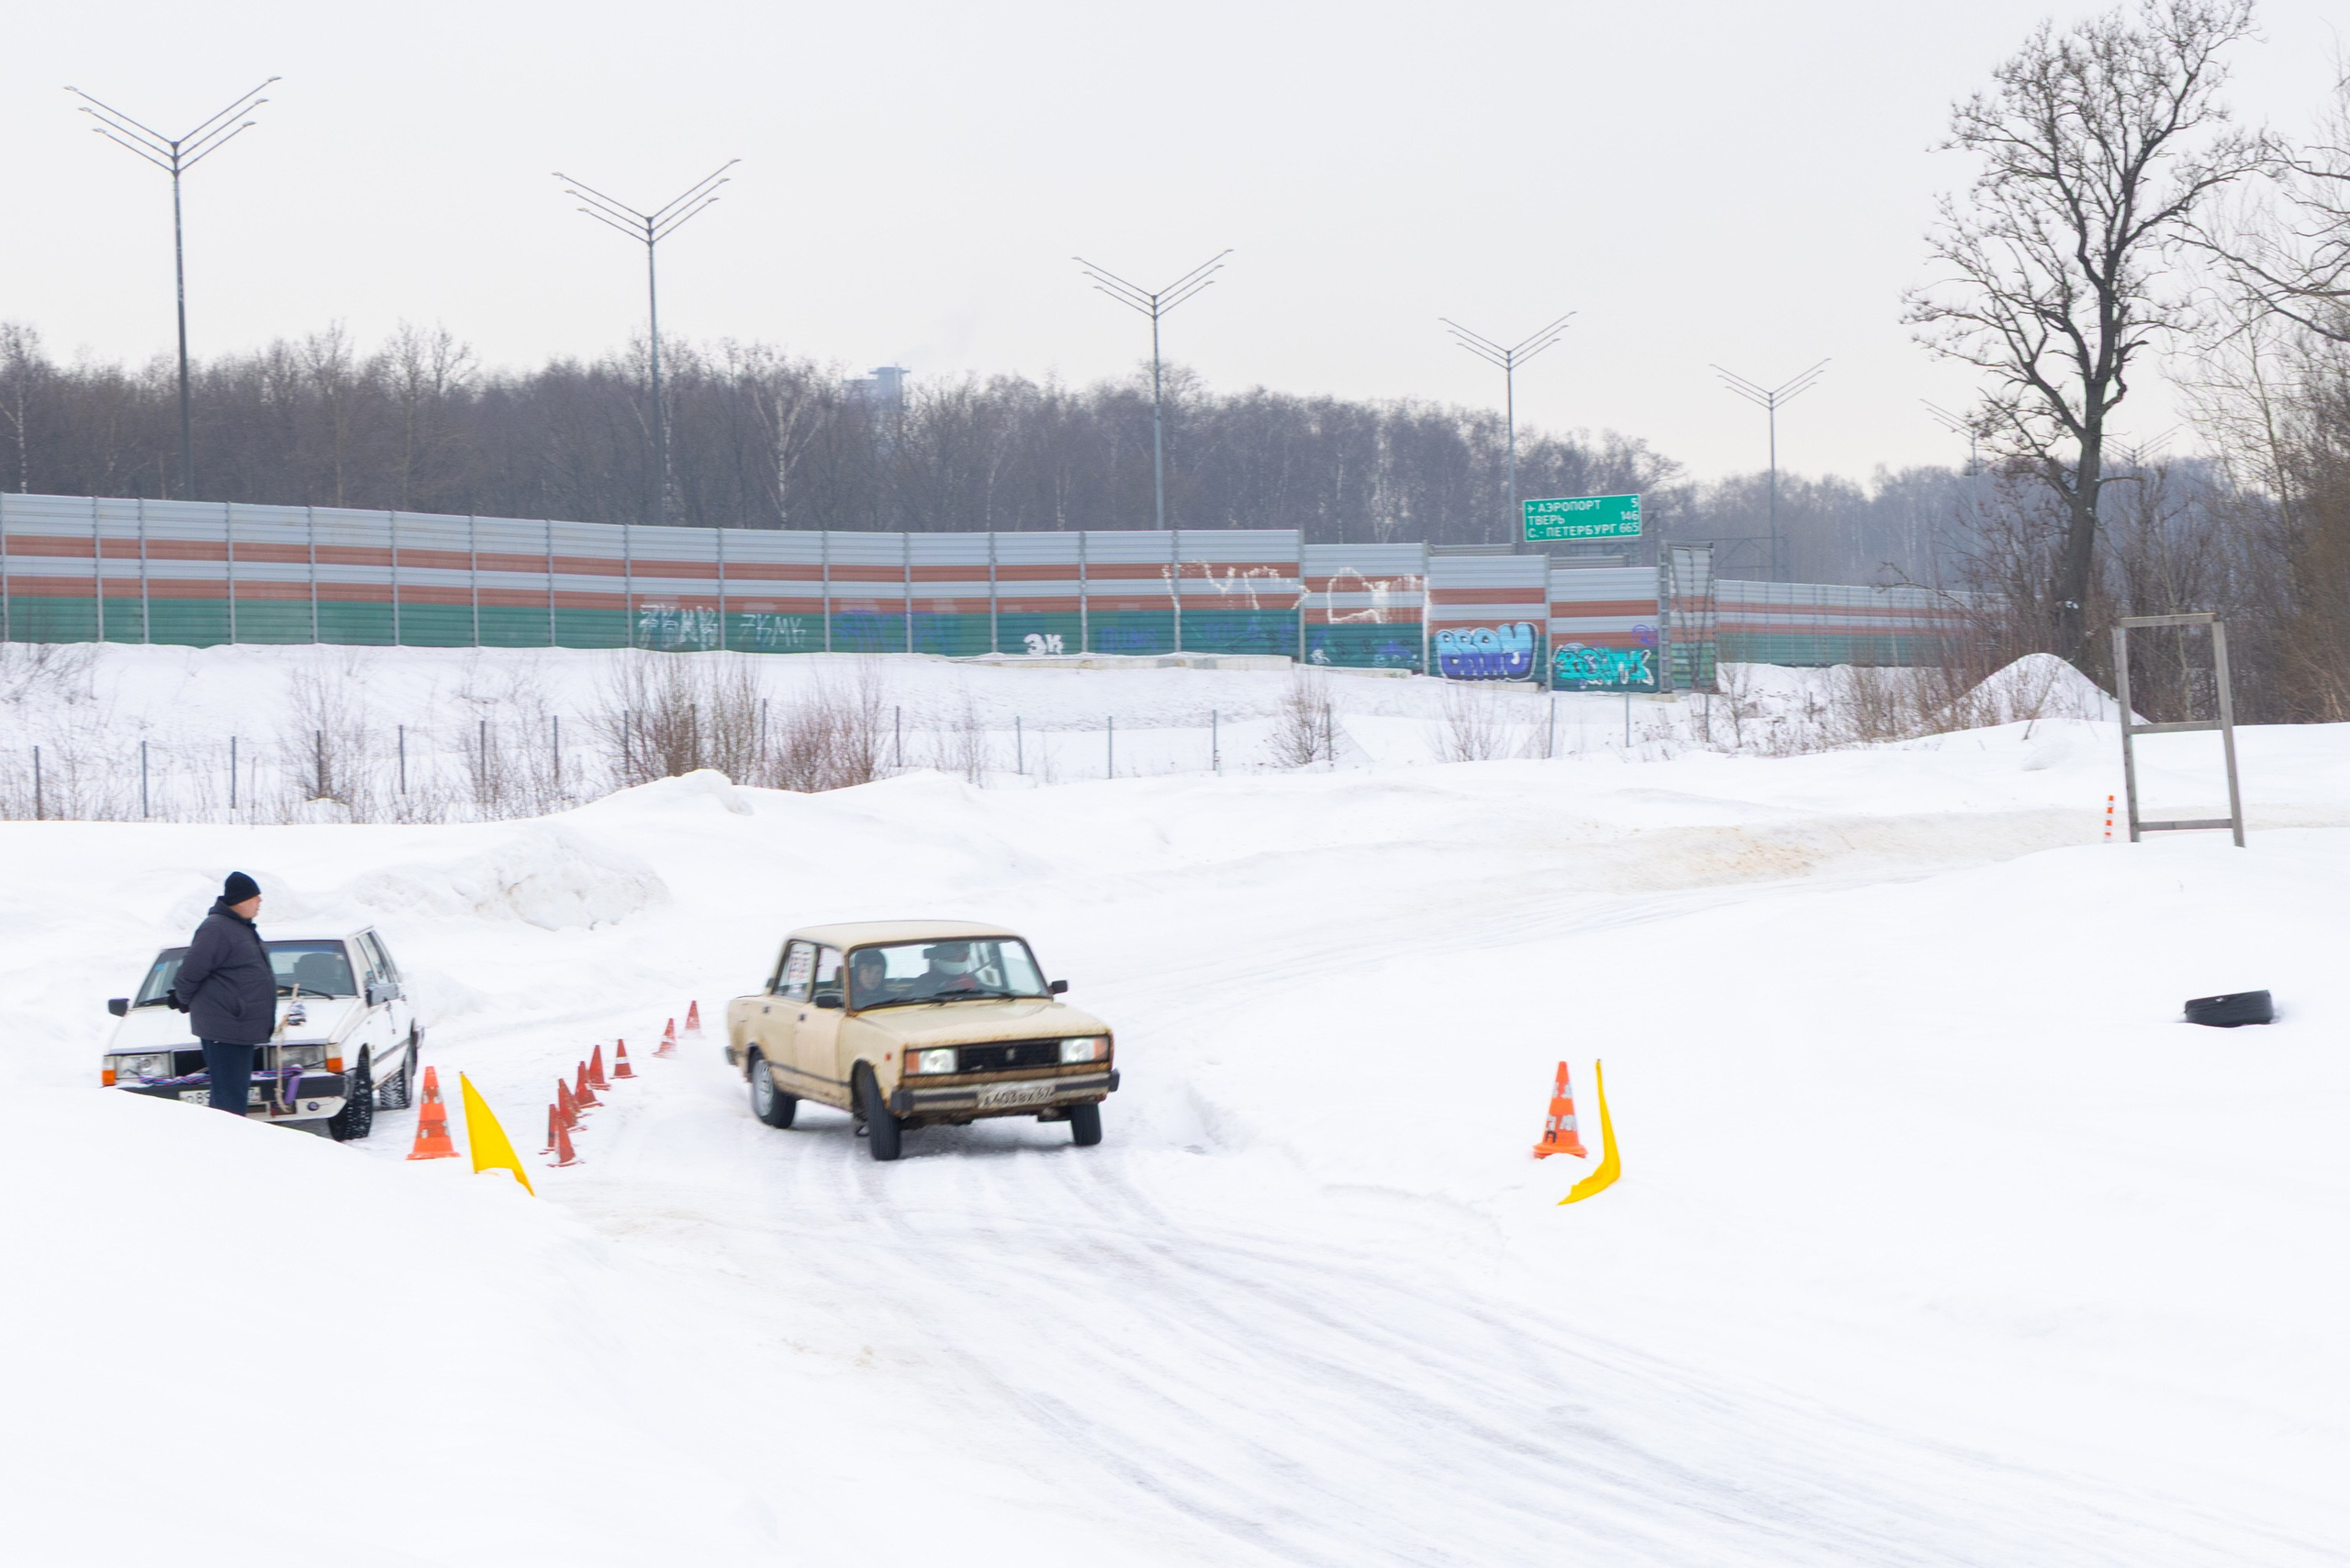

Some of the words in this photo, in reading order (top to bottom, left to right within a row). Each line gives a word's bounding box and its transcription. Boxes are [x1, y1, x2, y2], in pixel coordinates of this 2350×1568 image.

[1538, 499, 1601, 513] АЭРОПОРТ
[1631, 498, 1639, 508] 5
[1528, 515, 1565, 526] ТВЕРЬ
[1620, 510, 1639, 521] 146
[1618, 522, 1639, 533] 665
